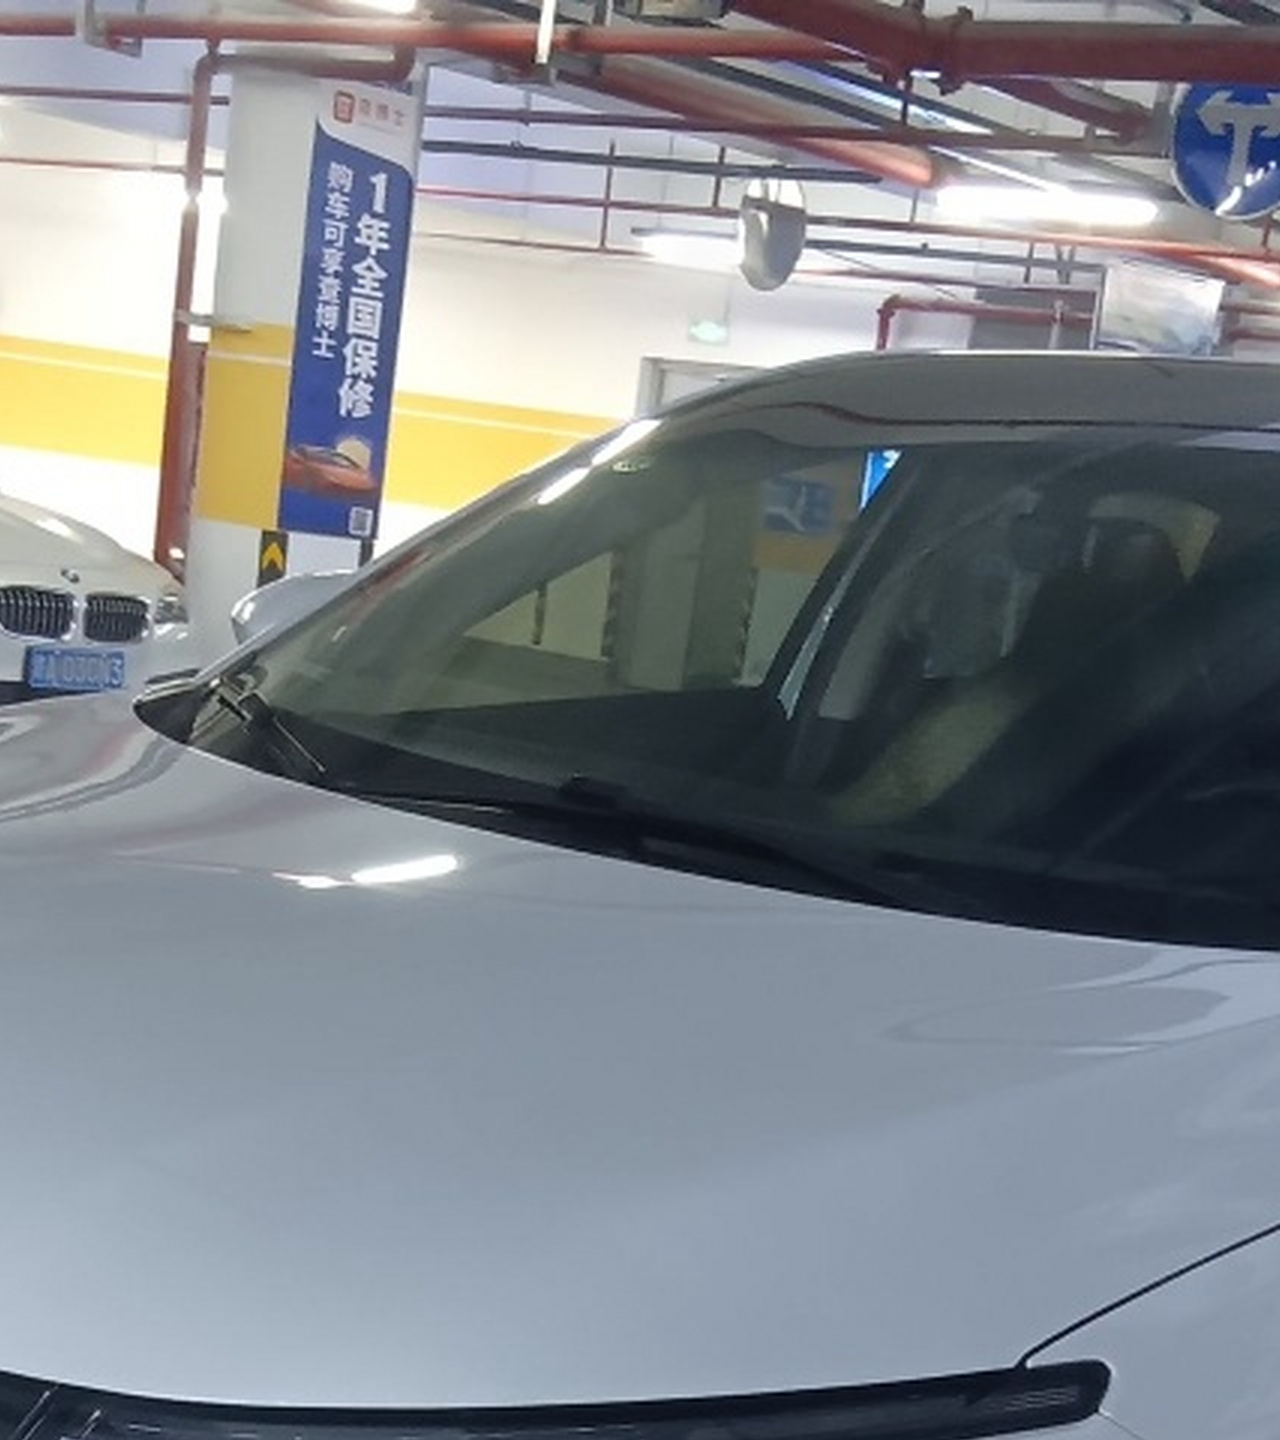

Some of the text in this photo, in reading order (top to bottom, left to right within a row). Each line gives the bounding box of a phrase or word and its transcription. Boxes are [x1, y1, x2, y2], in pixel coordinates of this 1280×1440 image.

[338, 171, 391, 419] 1年全国保修
